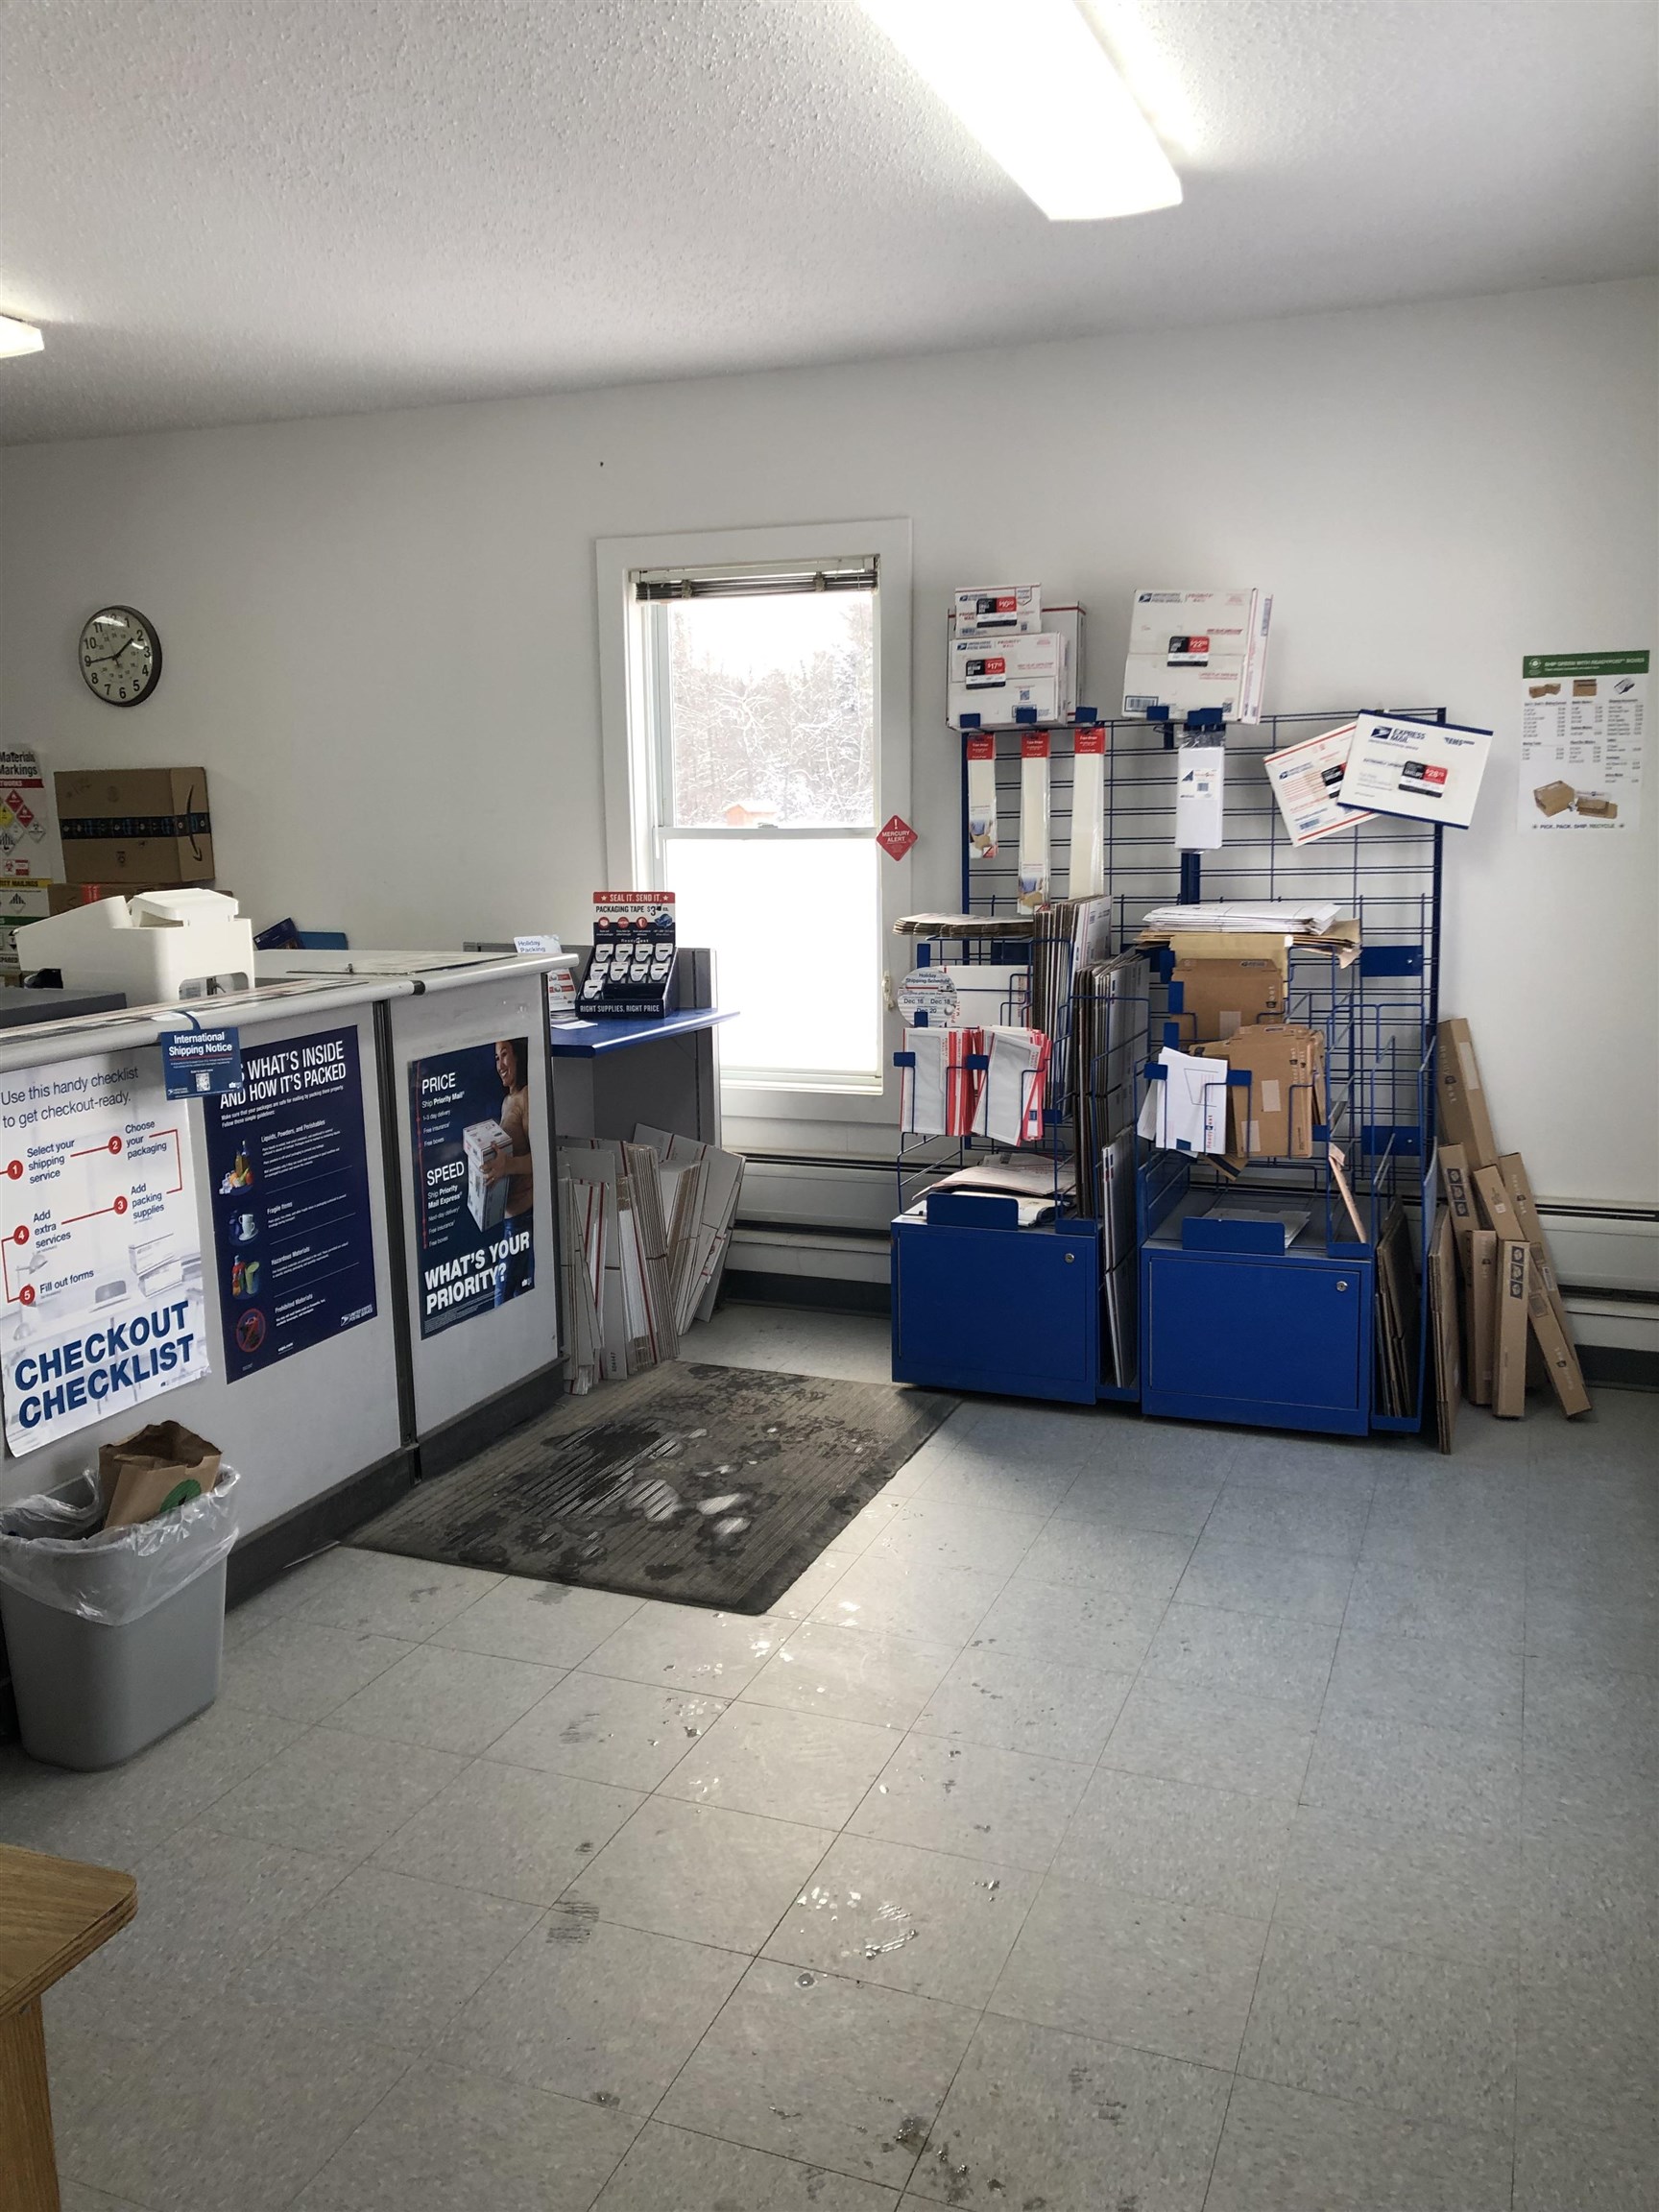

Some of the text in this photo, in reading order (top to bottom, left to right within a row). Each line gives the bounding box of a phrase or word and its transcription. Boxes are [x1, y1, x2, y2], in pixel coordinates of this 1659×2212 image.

[93, 621, 104, 634] 11
[125, 617, 131, 628] 1
[136, 629, 144, 641] 2
[84, 637, 97, 650] 10
[143, 646, 151, 658] 3
[84, 655, 92, 667] 9
[142, 664, 149, 677] 4
[90, 672, 99, 685] 8
[132, 679, 140, 692] 5
[104, 684, 111, 695] 7
[118, 686, 127, 699] 6
[1393, 728, 1426, 740] EXPRESS
[609, 894, 662, 902] SEAL IT. SEND IT.
[580, 1004, 597, 1013] RIGHT
[597, 1004, 624, 1014] SUPPLIES,
[626, 1004, 643, 1013] RIGHT
[173, 1031, 225, 1045] International
[168, 1042, 232, 1057] Shipping Notice
[247, 1050, 300, 1081] WHAT'S
[302, 1041, 345, 1069] INSIDE
[1, 1067, 139, 1106] Use this handy checklist
[220, 1062, 347, 1110] AND HOW IT'S PACKED
[421, 1071, 456, 1095] PRICE
[421, 1099, 434, 1110] Ship
[433, 1094, 451, 1106] Priority
[3, 1091, 132, 1129] to get checkout-ready.
[125, 1119, 156, 1135] Choose
[27, 1139, 75, 1159] Select your
[111, 1136, 144, 1150] 2 your
[127, 1142, 167, 1161] packaging
[28, 1154, 65, 1172] shipping
[12, 1165, 60, 1185] 1 service
[426, 1161, 465, 1186] SPEED
[131, 1183, 147, 1195] Add
[427, 1185, 458, 1200] Ship Priority
[116, 1191, 162, 1210] 3 packing
[428, 1199, 440, 1210] Mail
[33, 1210, 51, 1223] Add
[132, 1203, 165, 1220] supplies
[34, 1222, 57, 1236] extra
[17, 1229, 71, 1249] 4 services
[424, 1231, 530, 1291] WHAT'S YOUR
[23, 1269, 94, 1300] 5 Fill out forms
[426, 1262, 507, 1315] PRIORITY?
[14, 1301, 189, 1391] CHECKOUT
[18, 1333, 194, 1429] CHECKLIST
